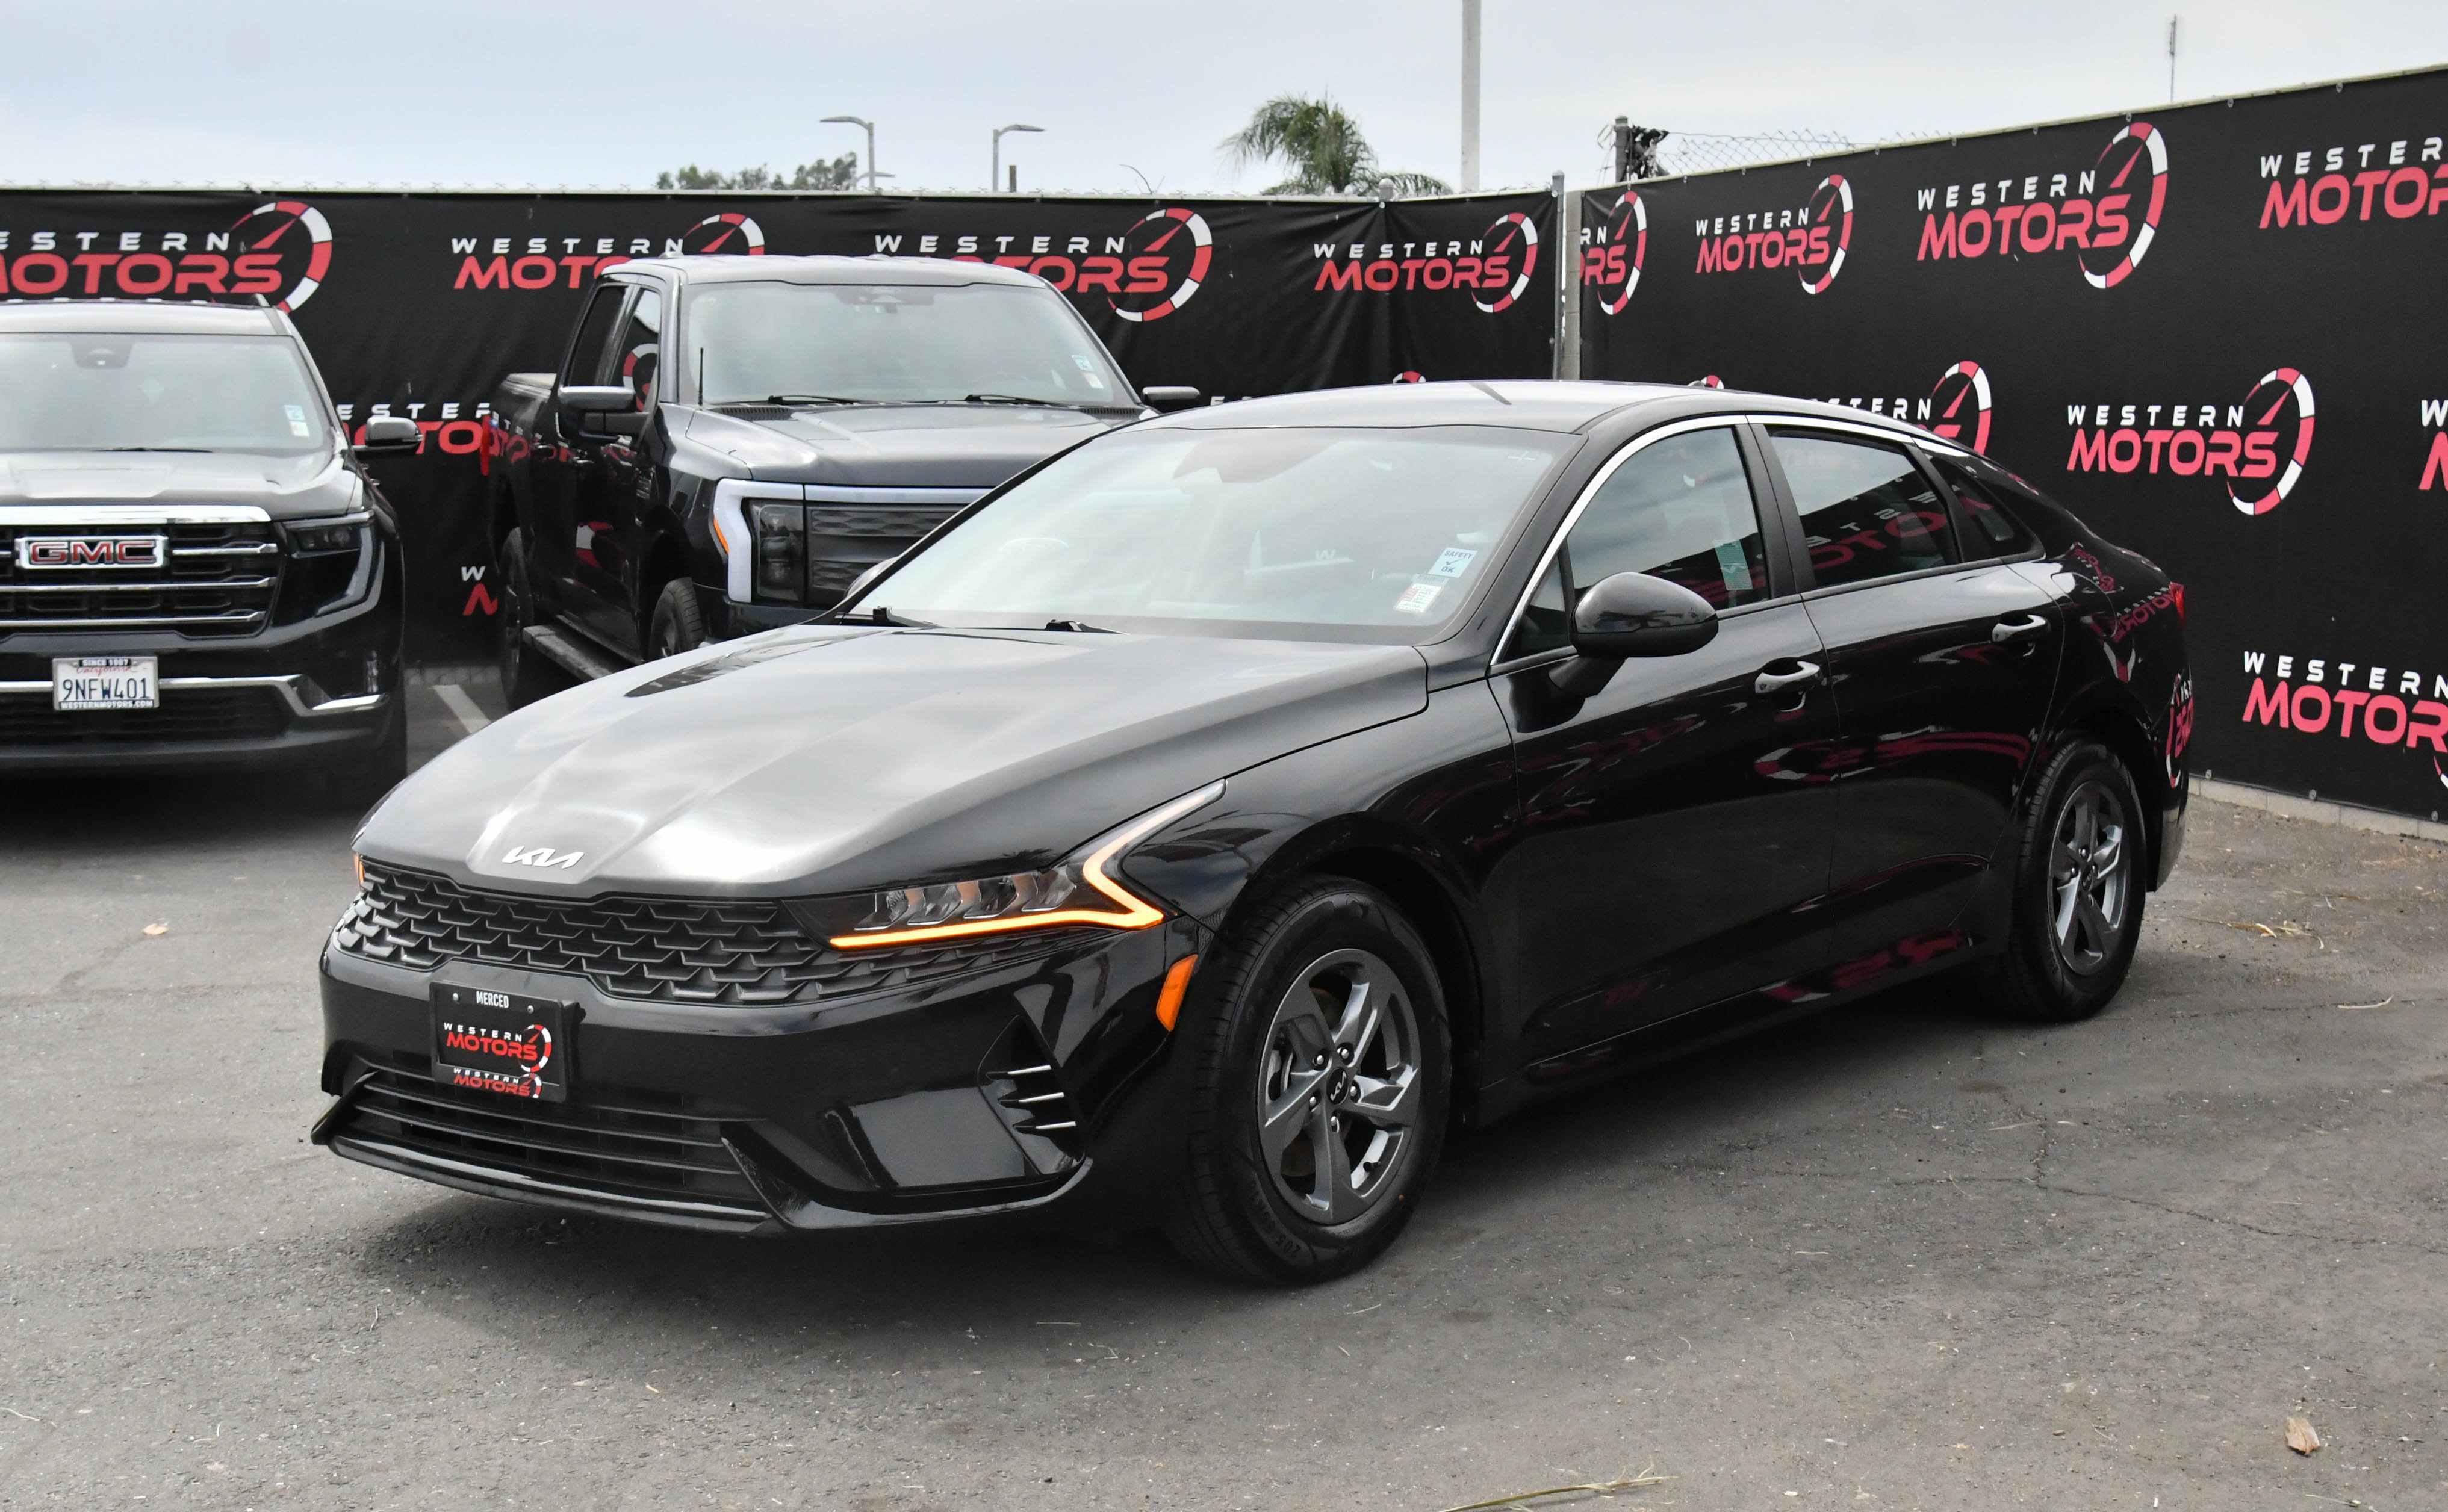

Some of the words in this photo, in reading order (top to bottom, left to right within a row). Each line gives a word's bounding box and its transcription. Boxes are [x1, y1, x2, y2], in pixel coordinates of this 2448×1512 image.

[1918, 170, 2095, 211] WESTERN
[1696, 208, 1809, 236] WESTERN
[1917, 194, 2131, 261] MOTORS
[452, 238, 684, 255] WESTERN
[875, 235, 1125, 254] WESTERN
[1314, 240, 1483, 259] WESTERN
[1695, 226, 1831, 273] MOTORS
[0, 253, 283, 294] OTORS
[1315, 255, 1510, 291] MOTORS
[2067, 405, 2244, 427] WESTERN
[2067, 428, 2279, 478] MOTORS
[30, 541, 157, 564] GMC
[1444, 550, 1474, 559] SAFETY
[63, 678, 150, 701] 9NFW401
[61, 700, 154, 708] WESTERNMOTORS.COM
[476, 991, 510, 1009] MERCED
[444, 1023, 522, 1042] WESTERN
[446, 1032, 538, 1061] MOTORS
[453, 1067, 519, 1084] WESTERN
[453, 1074, 530, 1097] MOTORS
